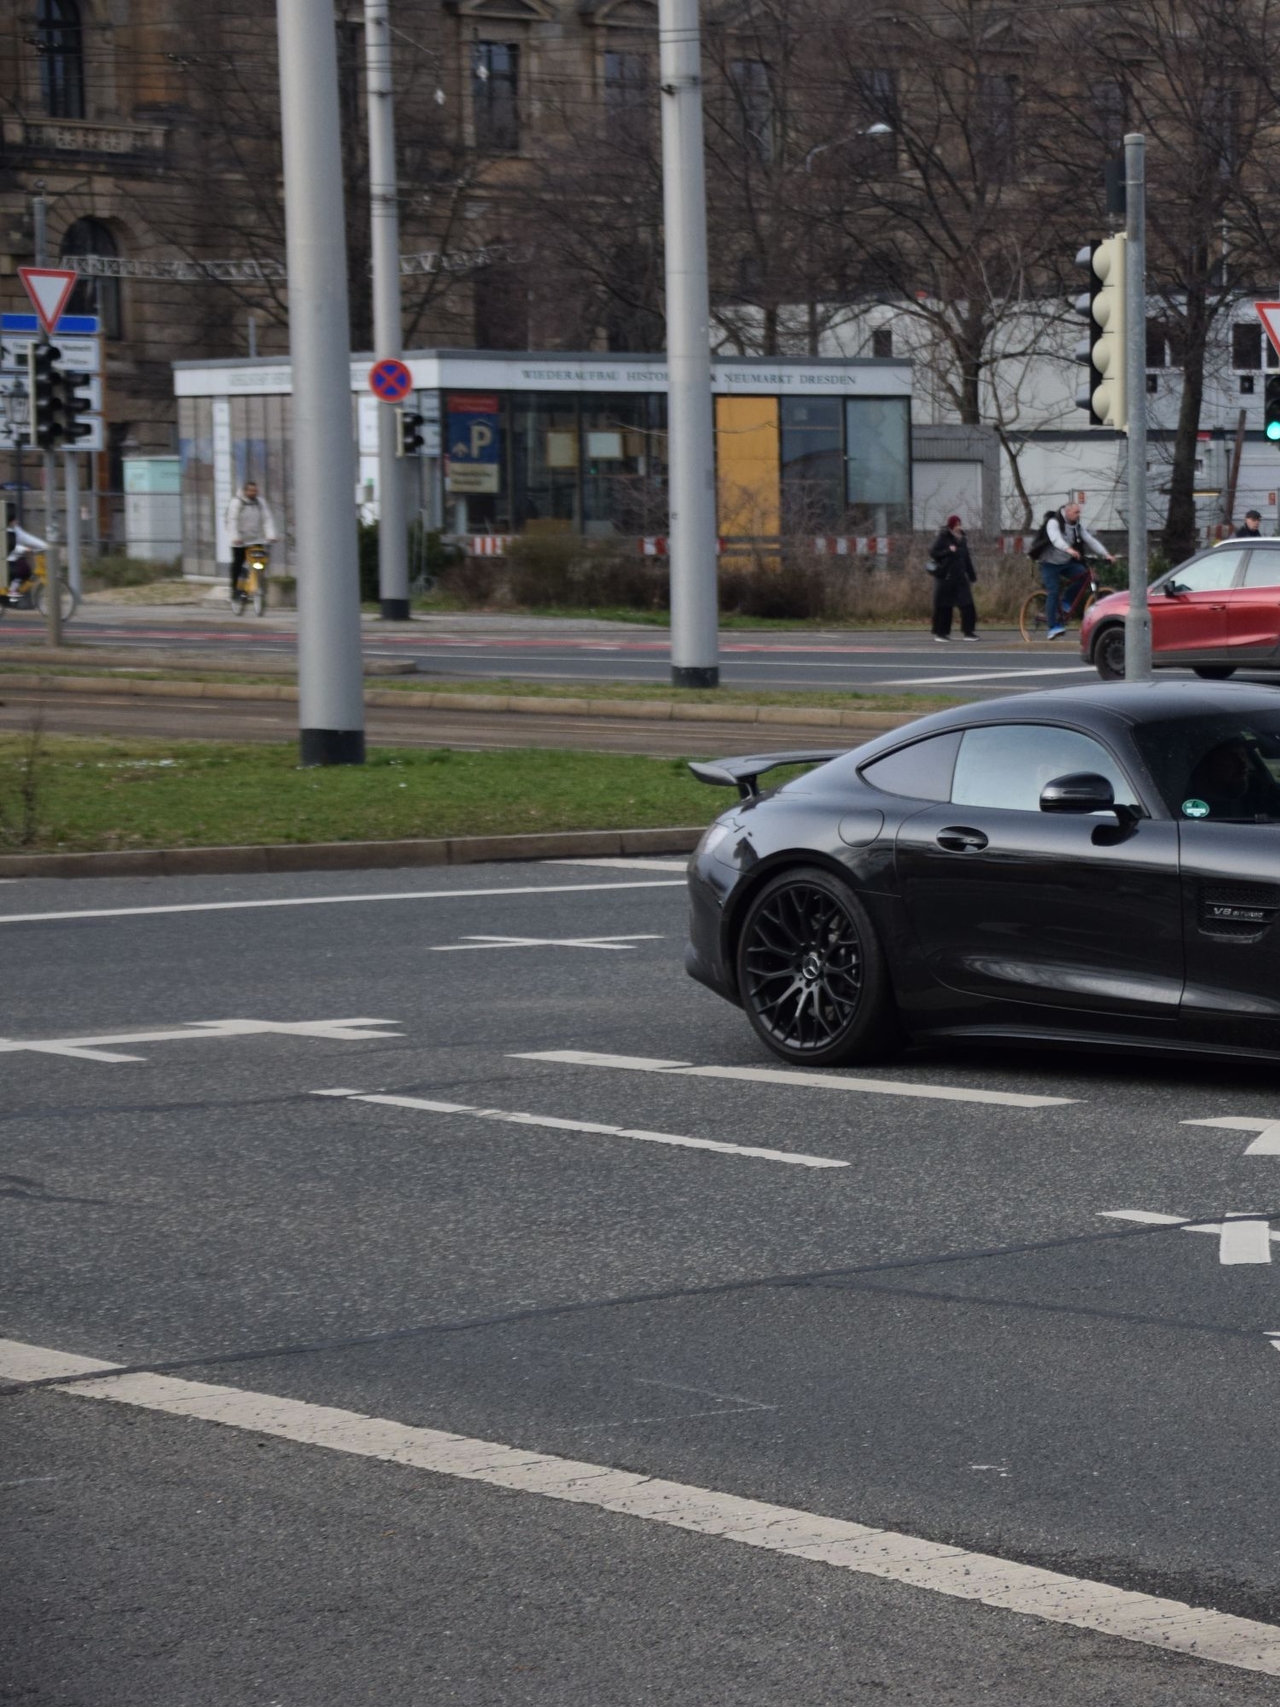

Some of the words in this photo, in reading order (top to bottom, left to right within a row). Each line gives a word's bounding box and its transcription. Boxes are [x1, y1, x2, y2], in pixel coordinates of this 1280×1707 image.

[521, 370, 618, 381] WIEDERAUFBAU
[724, 373, 793, 384] NEUMARKT
[799, 374, 857, 385] DRESDEN
[471, 425, 492, 458] P
[1214, 907, 1232, 915] V8
